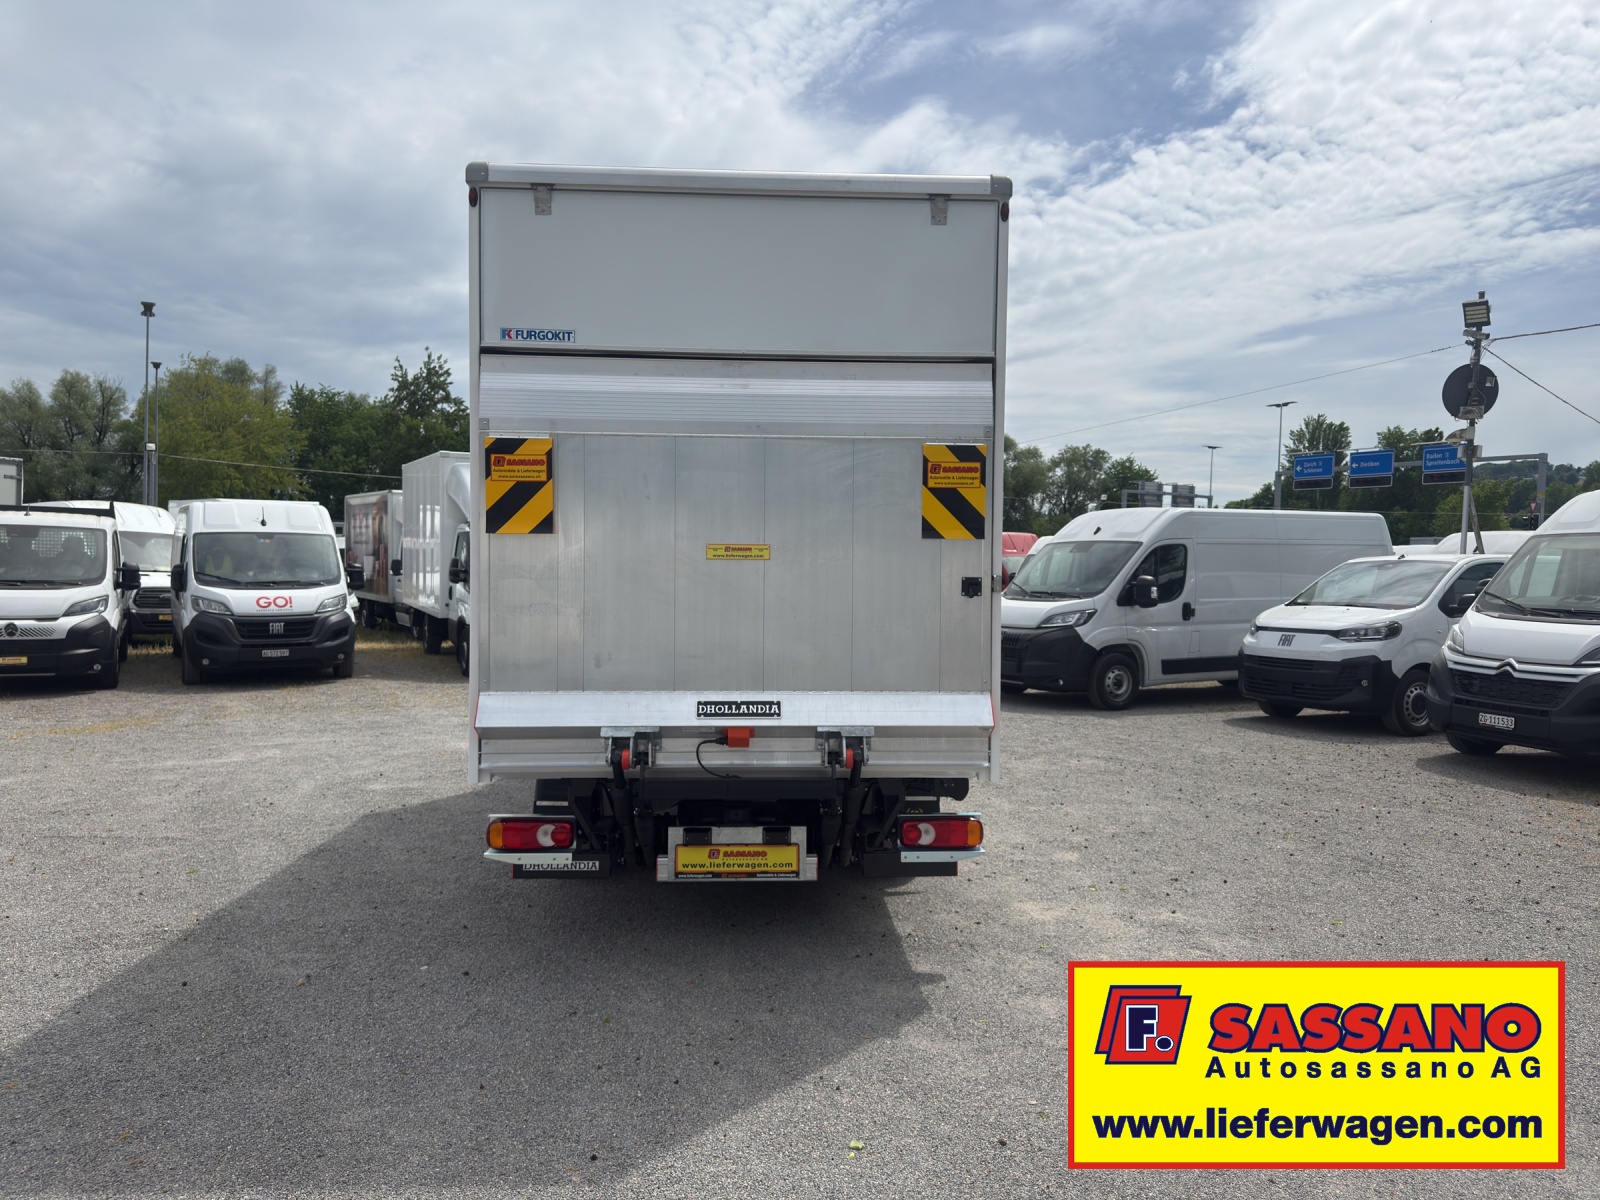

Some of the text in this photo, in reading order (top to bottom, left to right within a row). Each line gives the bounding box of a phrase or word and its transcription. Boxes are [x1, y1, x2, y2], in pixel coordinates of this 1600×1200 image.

[515, 329, 573, 341] FURGOKIT
[506, 458, 545, 467] SASSANO
[1426, 459, 1459, 467] Spreitenbach
[941, 465, 979, 473] SASSANO
[256, 596, 293, 608] GO!
[269, 622, 285, 634] FIAT
[1277, 633, 1296, 647] FIAT
[698, 704, 780, 714] DHOLLANDIA
[722, 850, 768, 858] SASSANO
[524, 862, 598, 870] DHOLLANDIA
[682, 861, 793, 869] www.lieferwagen.com
